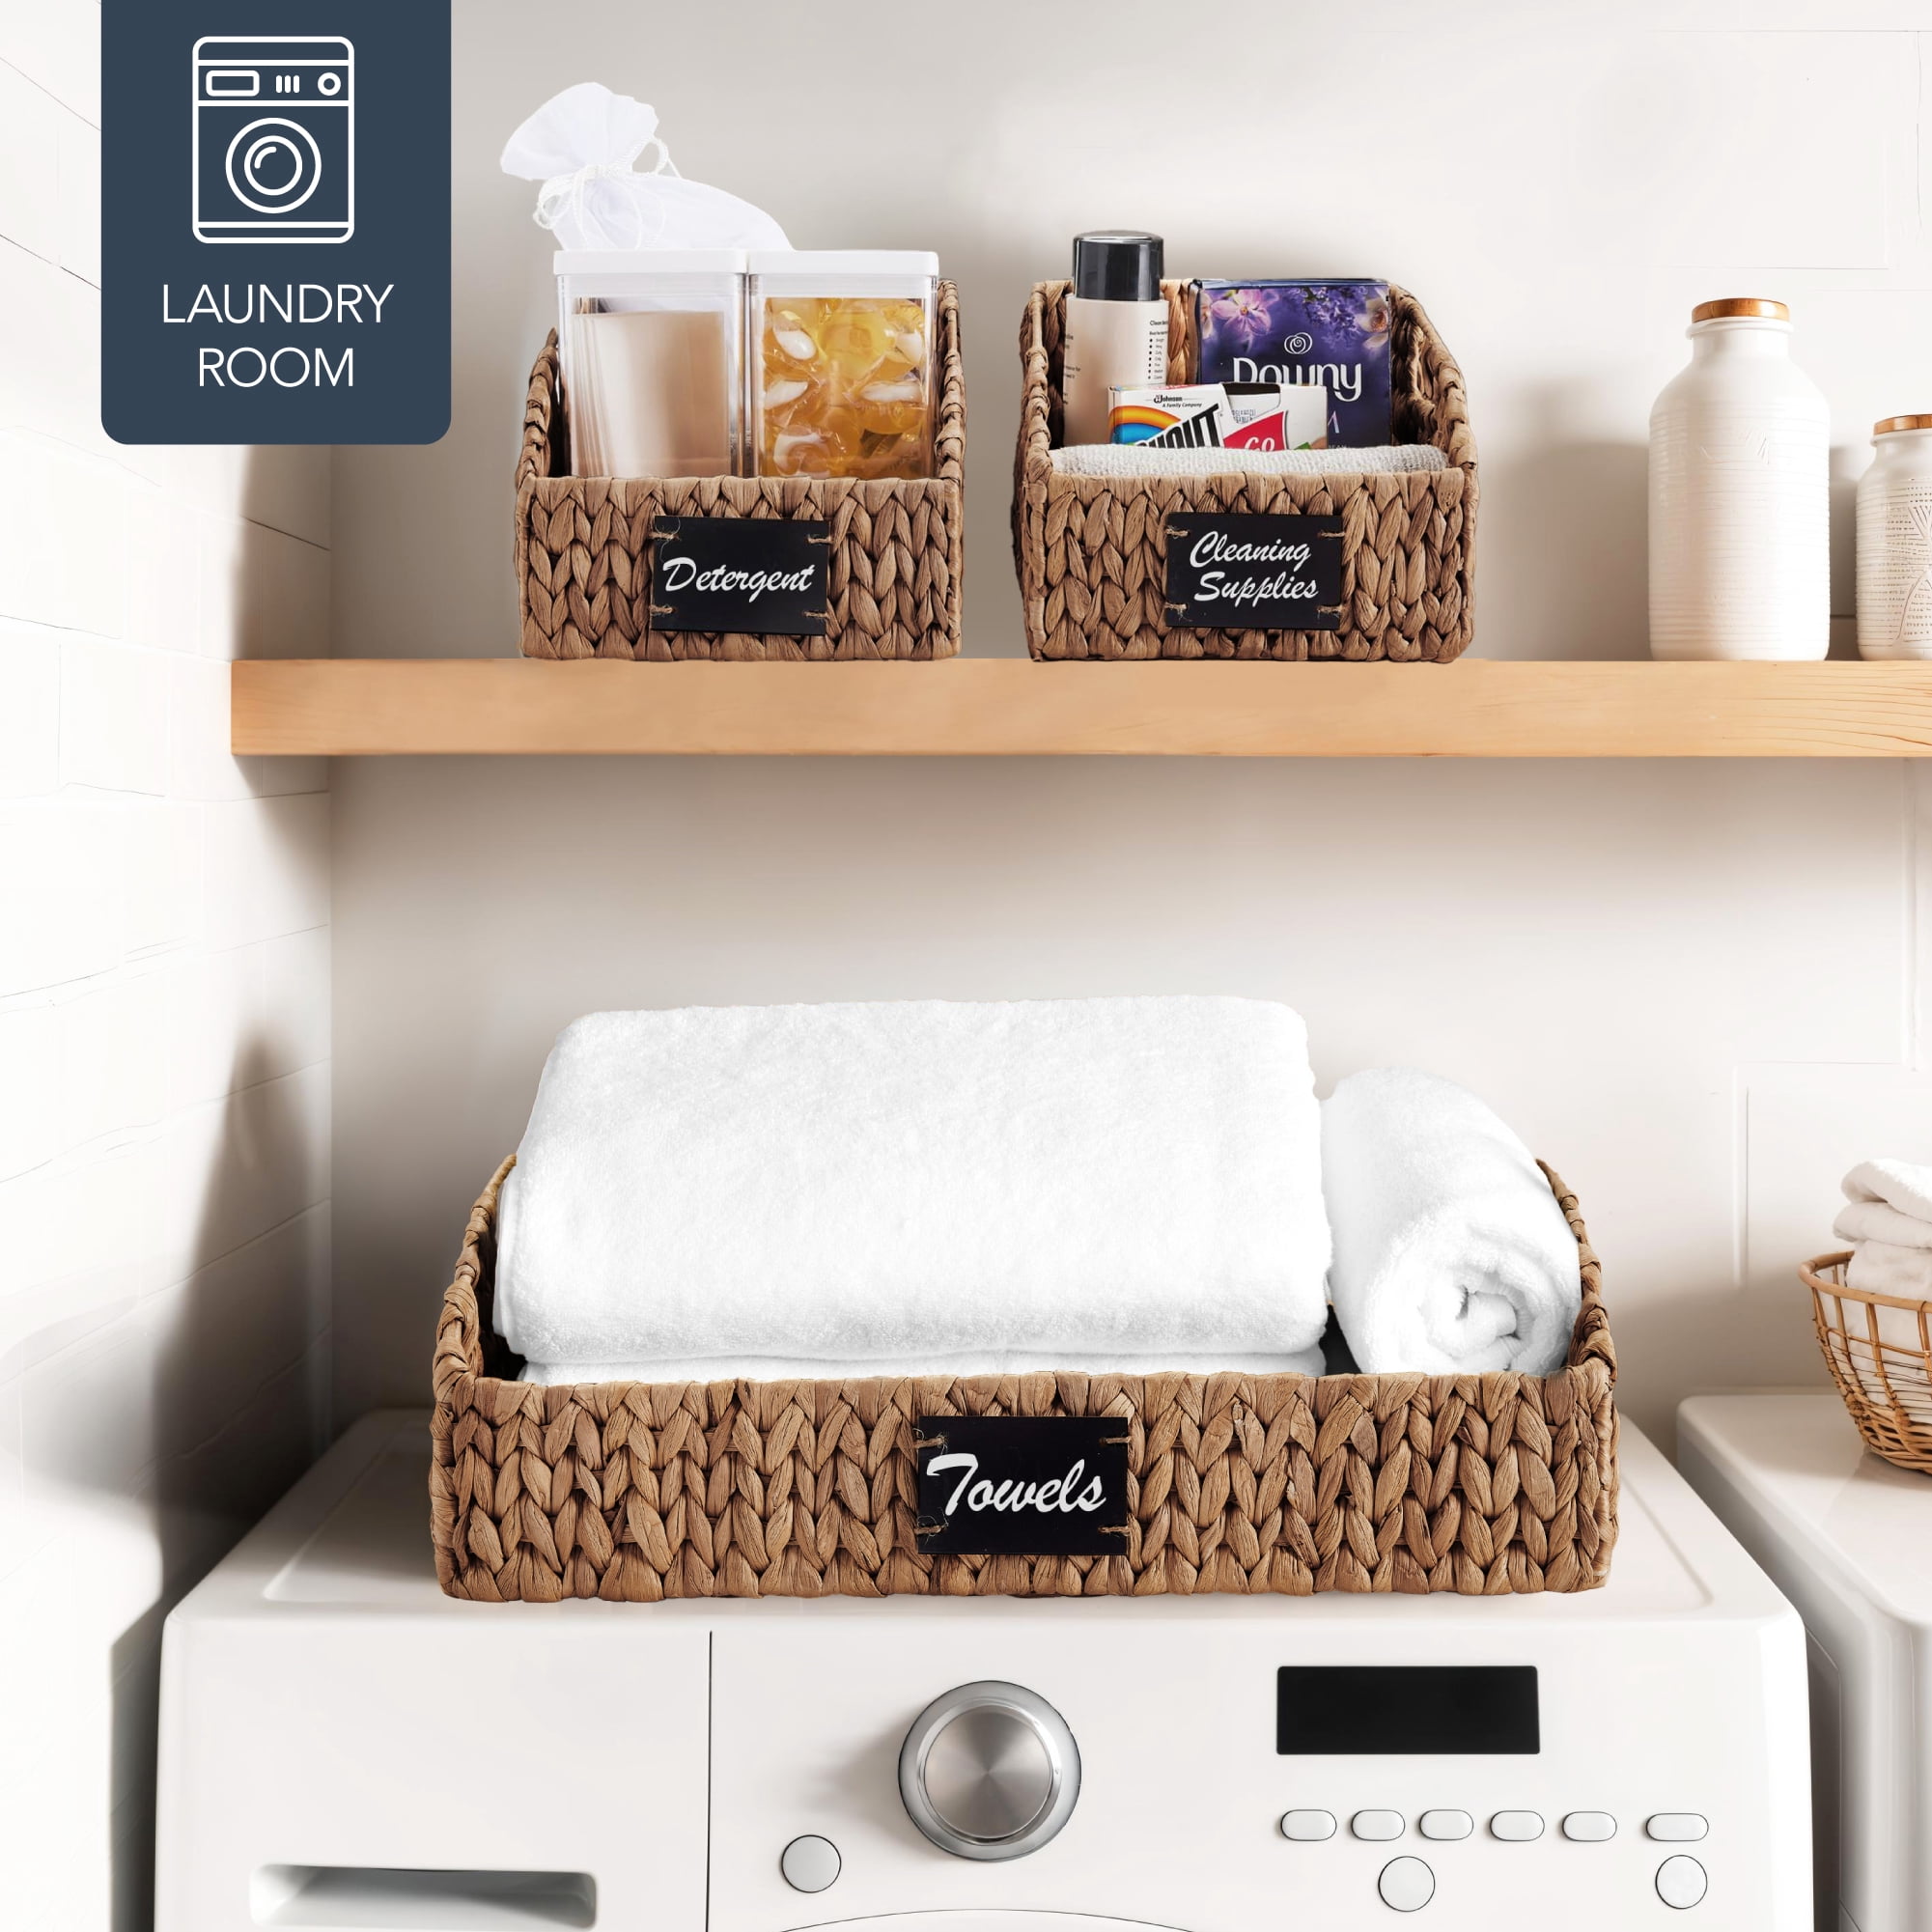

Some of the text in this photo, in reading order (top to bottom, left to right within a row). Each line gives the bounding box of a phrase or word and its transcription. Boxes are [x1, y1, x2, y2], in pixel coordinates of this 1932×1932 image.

[1233, 357, 1361, 402] Downy
[1137, 403, 1220, 448] OUT
[1190, 531, 1310, 572] Cleaning
[663, 557, 814, 602] Detergent
[1194, 572, 1318, 606] Supplies
[927, 1453, 1106, 1515] Towels
